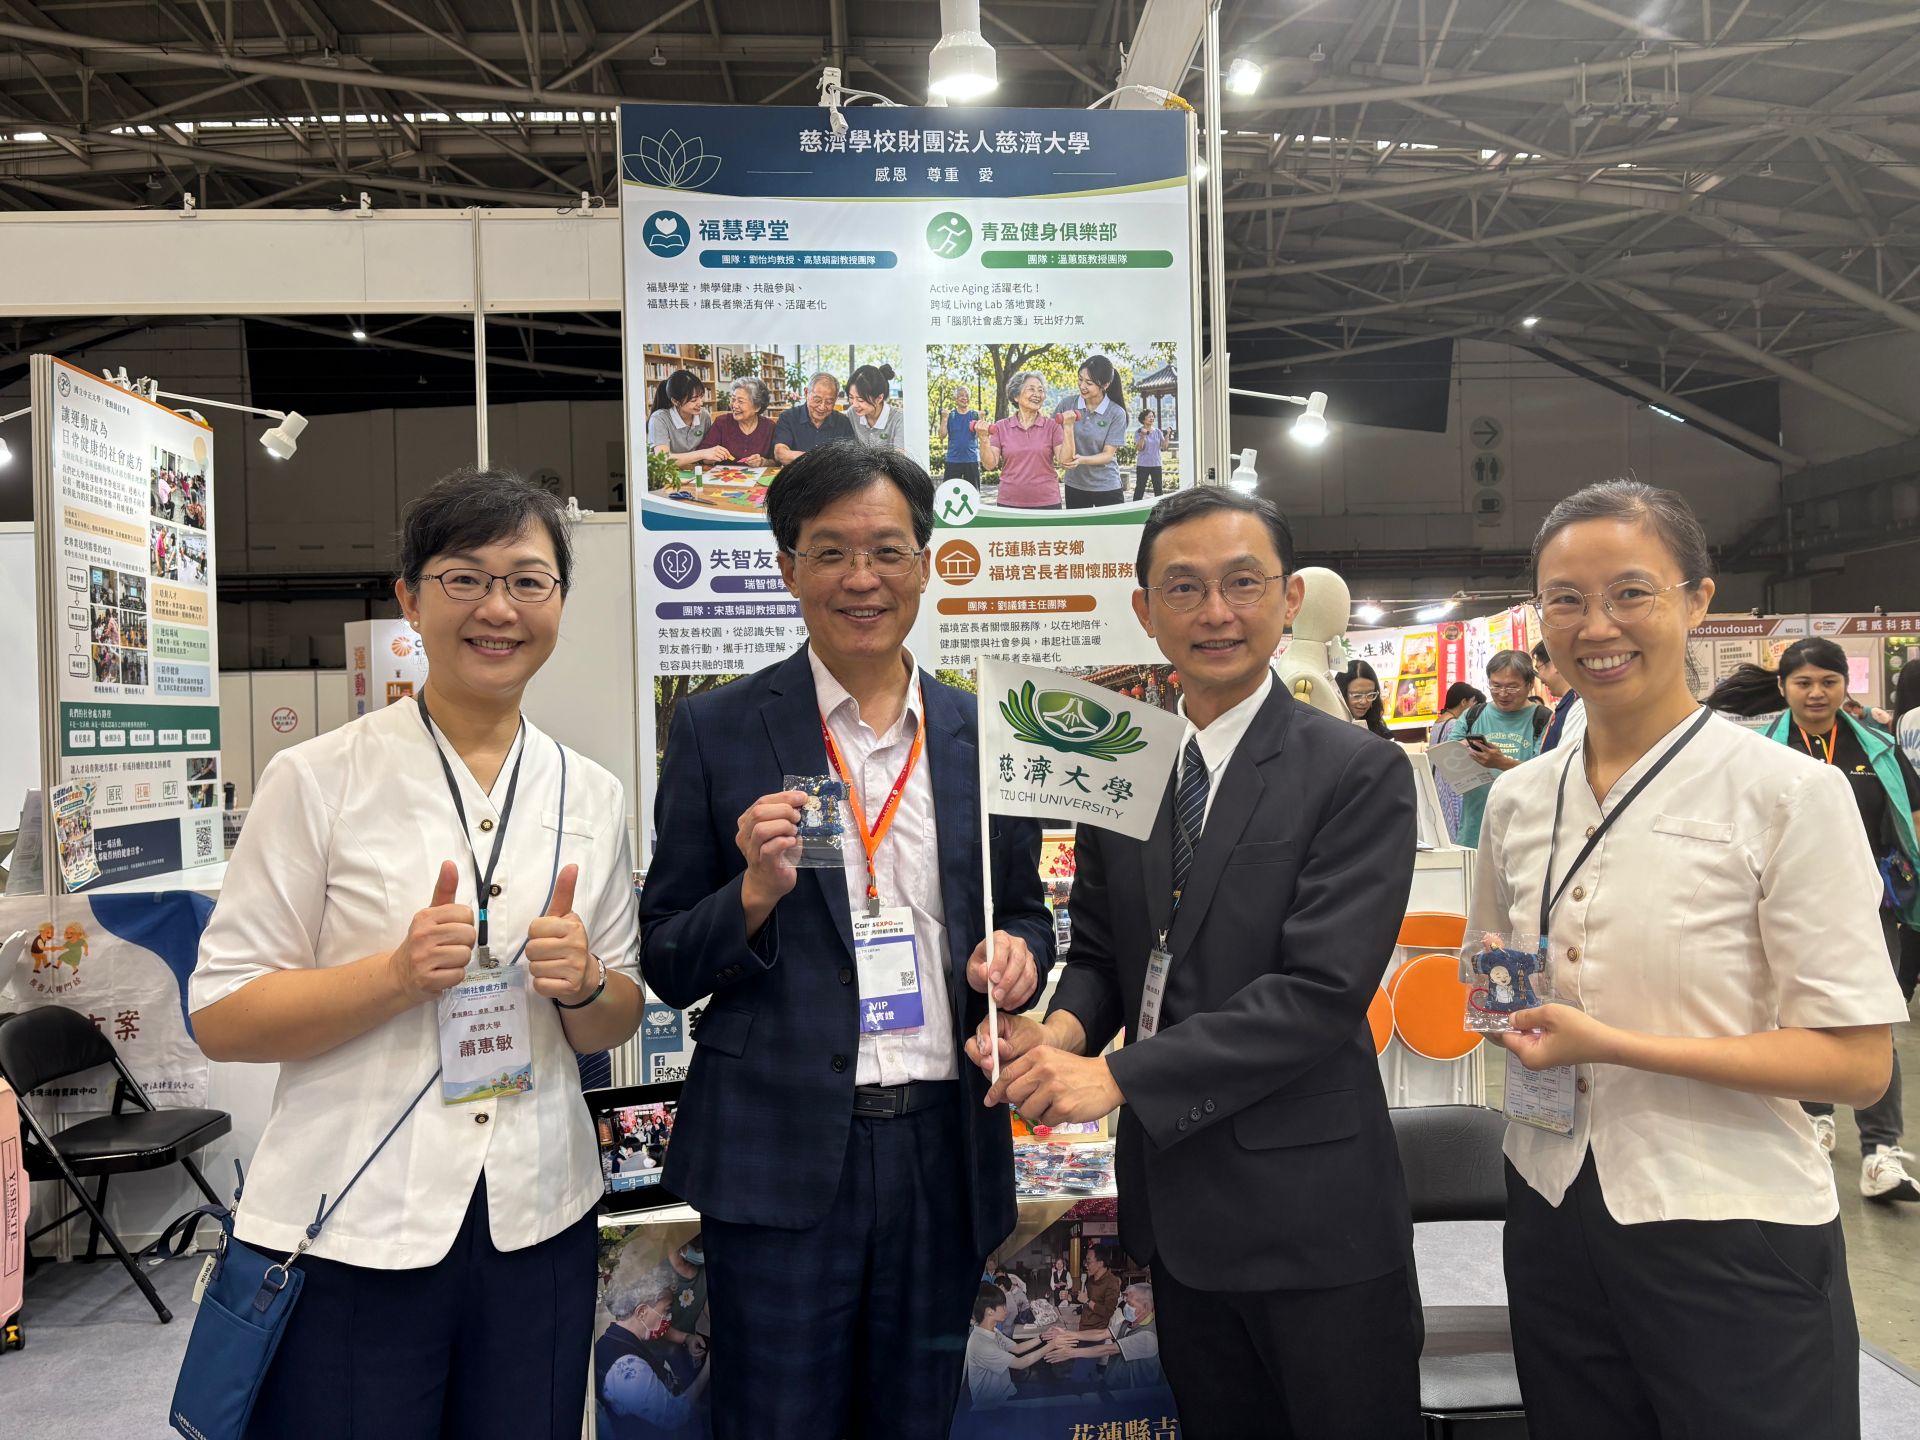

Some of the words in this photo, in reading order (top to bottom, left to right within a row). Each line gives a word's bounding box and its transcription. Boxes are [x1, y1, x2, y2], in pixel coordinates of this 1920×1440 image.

[799, 130, 1091, 154] 慈濟學校財團法人慈濟大學
[875, 167, 907, 182] 感恩
[926, 167, 959, 182] 尊重
[978, 167, 994, 182] 愛
[699, 219, 789, 241] 福慧學堂
[981, 222, 1118, 242] 青盈健身俱樂部
[930, 283, 960, 293] Active
[962, 284, 990, 295] Aging
[930, 299, 951, 310] 跨域
[953, 299, 983, 311] Living
[985, 299, 1003, 309] Lab
[61, 405, 108, 439] 讓運動成為
[62, 428, 143, 473] 日常健康的社會處方
[988, 540, 1085, 558] 花蓮縣吉安鄉
[710, 549, 782, 570] 失智友
[988, 562, 1139, 582] 福境宮長者關懷服務
[658, 626, 809, 639] 失智友善校園，從認識失智、理
[659, 660, 745, 671] 包容與共融的環境
[999, 753, 1134, 804] 慈濟大學
[108, 788, 122, 802] 居民
[165, 783, 177, 796] 地方
[1000, 789, 1016, 801] TZU
[1017, 791, 1036, 803] CHI
[1039, 794, 1124, 820] UNIVERSITY
[456, 982, 508, 996] 新社會處方館
[870, 1001, 889, 1011] VIP
[469, 1021, 502, 1033] 慈濟大學
[645, 1026, 678, 1036] 慈濟大學
[458, 1033, 514, 1058] 蕭惠敏
